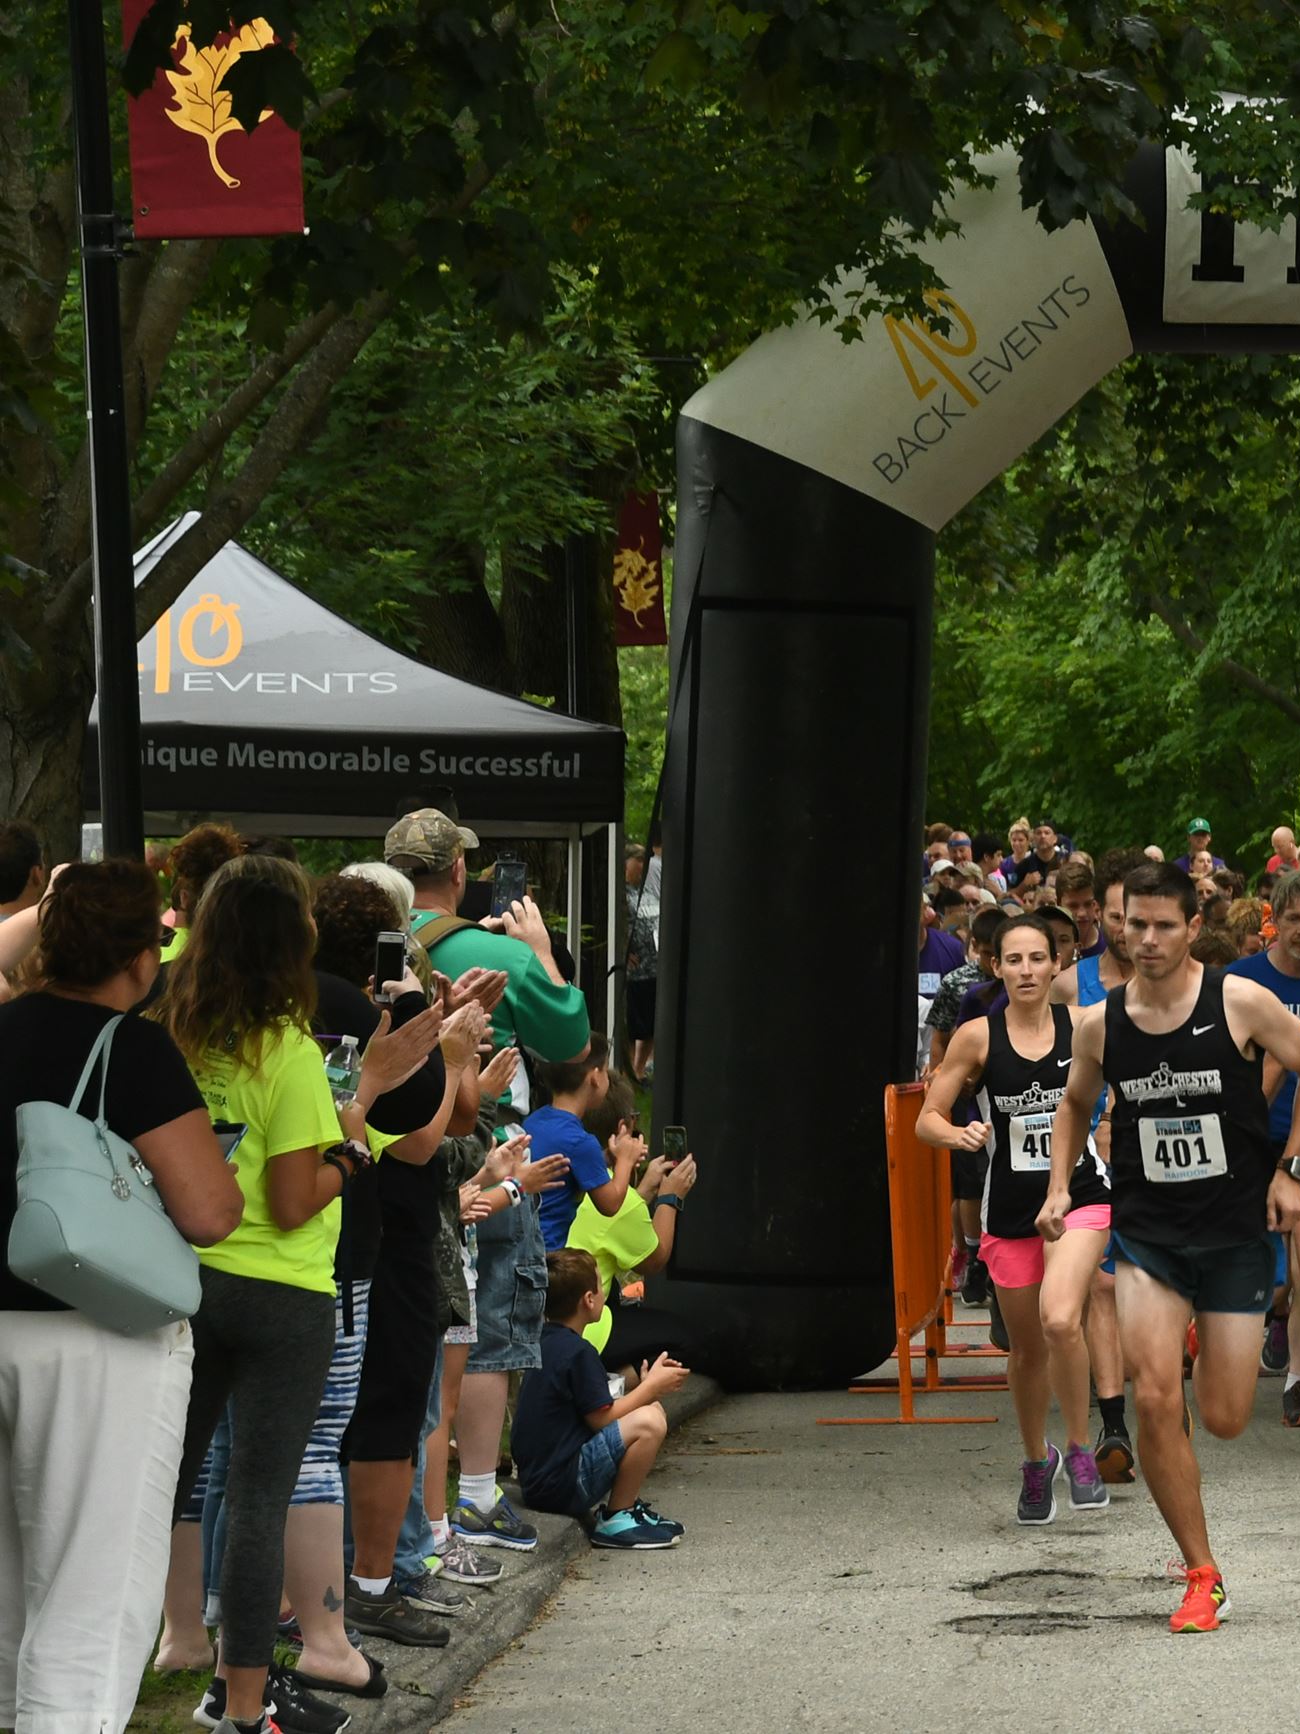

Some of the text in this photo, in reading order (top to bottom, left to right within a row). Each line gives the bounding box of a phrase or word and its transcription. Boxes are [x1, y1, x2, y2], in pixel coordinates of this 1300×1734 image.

[872, 275, 1091, 484] BACK EVENTS
[183, 671, 398, 694] EVENTS
[141, 740, 580, 778] ique Memorable Successful
[1025, 1121, 1050, 1132] STRONG
[1022, 1132, 1052, 1158] 40
[1155, 1136, 1212, 1169] 401
